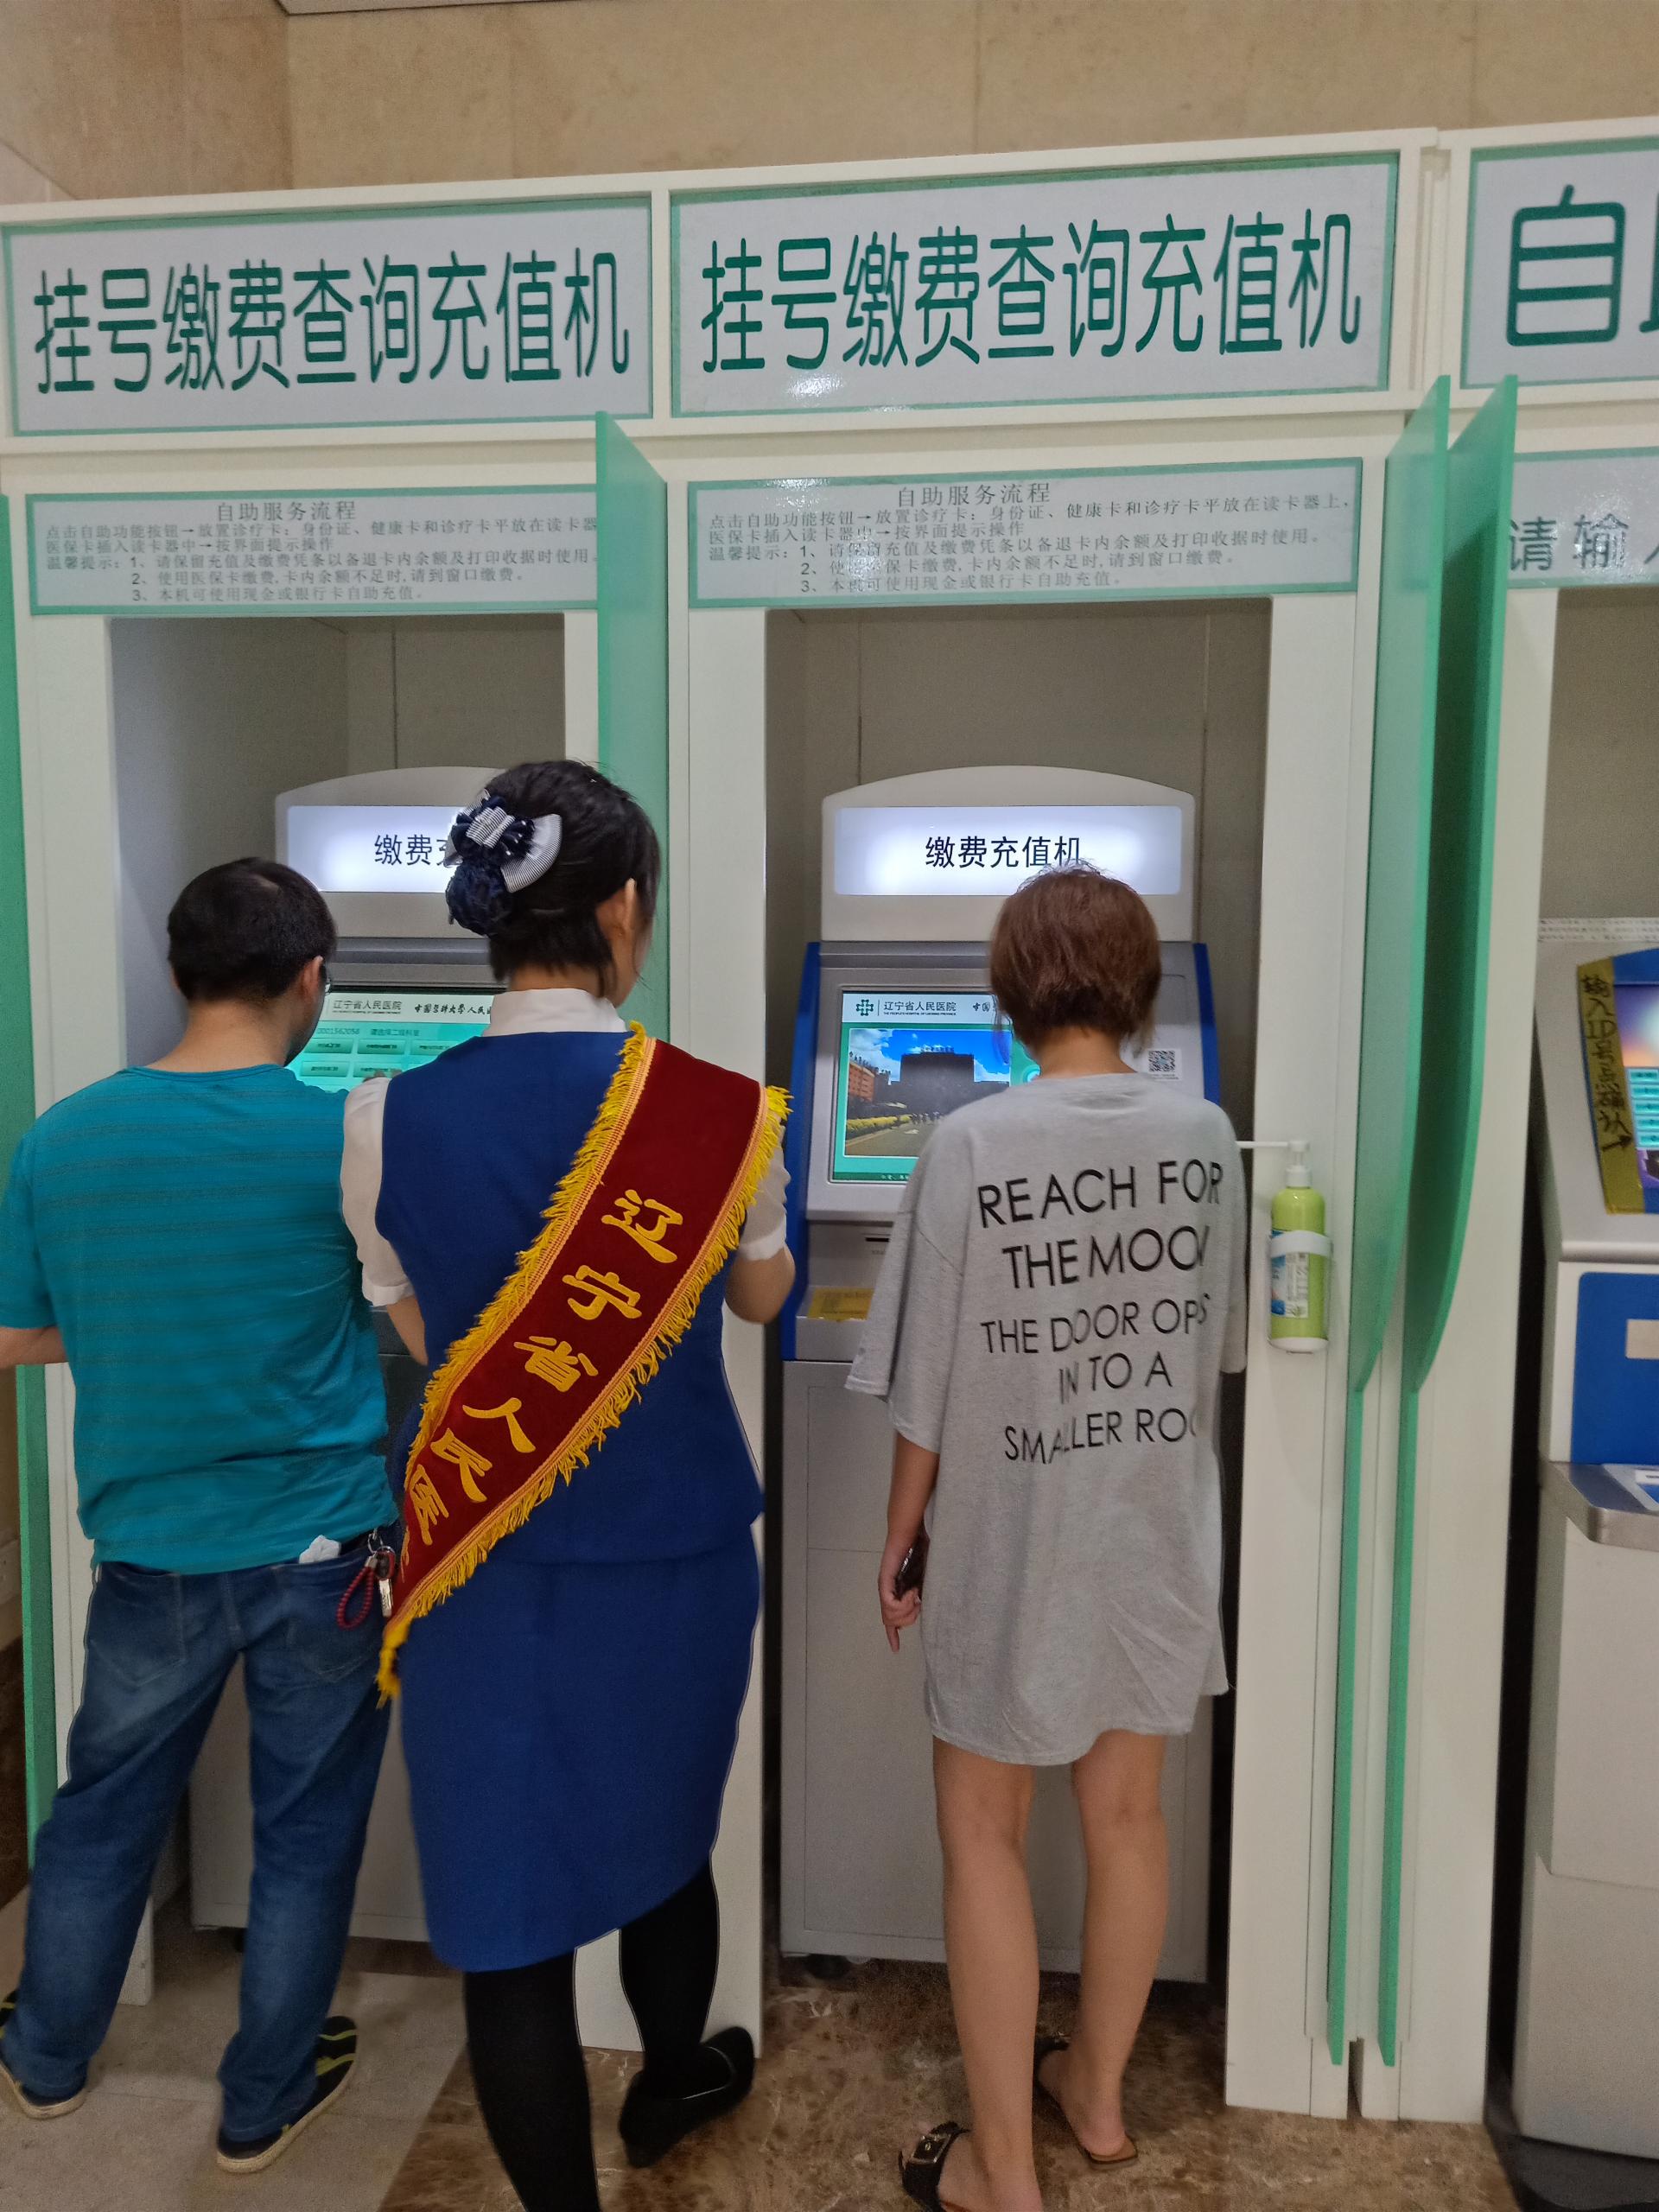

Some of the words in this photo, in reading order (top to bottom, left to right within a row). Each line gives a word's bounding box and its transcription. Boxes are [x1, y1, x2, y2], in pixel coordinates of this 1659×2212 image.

[1506, 184, 1659, 346] 自
[700, 208, 1360, 372] 挂号缴费查询充值机
[34, 247, 629, 394] 挂号缴费查询充值机
[217, 500, 356, 522] 自助服务流程
[899, 482, 1051, 507] 自助服务流程
[1509, 512, 1659, 573] 请输
[925, 836, 1081, 868] 缴费充值机
[334, 1000, 402, 1010] 辽宁省人民医院
[883, 1001, 957, 1012] 辽宁省人民医院
[977, 1166, 1136, 1229] REACH
[1158, 1159, 1224, 1205] FOR
[1002, 1238, 1080, 1289] THE
[980, 1319, 1039, 1354] THE
[1051, 1301, 1141, 1352] DOOR
[1145, 1351, 1173, 1388] A
[1135, 1408, 1197, 1443] RO
